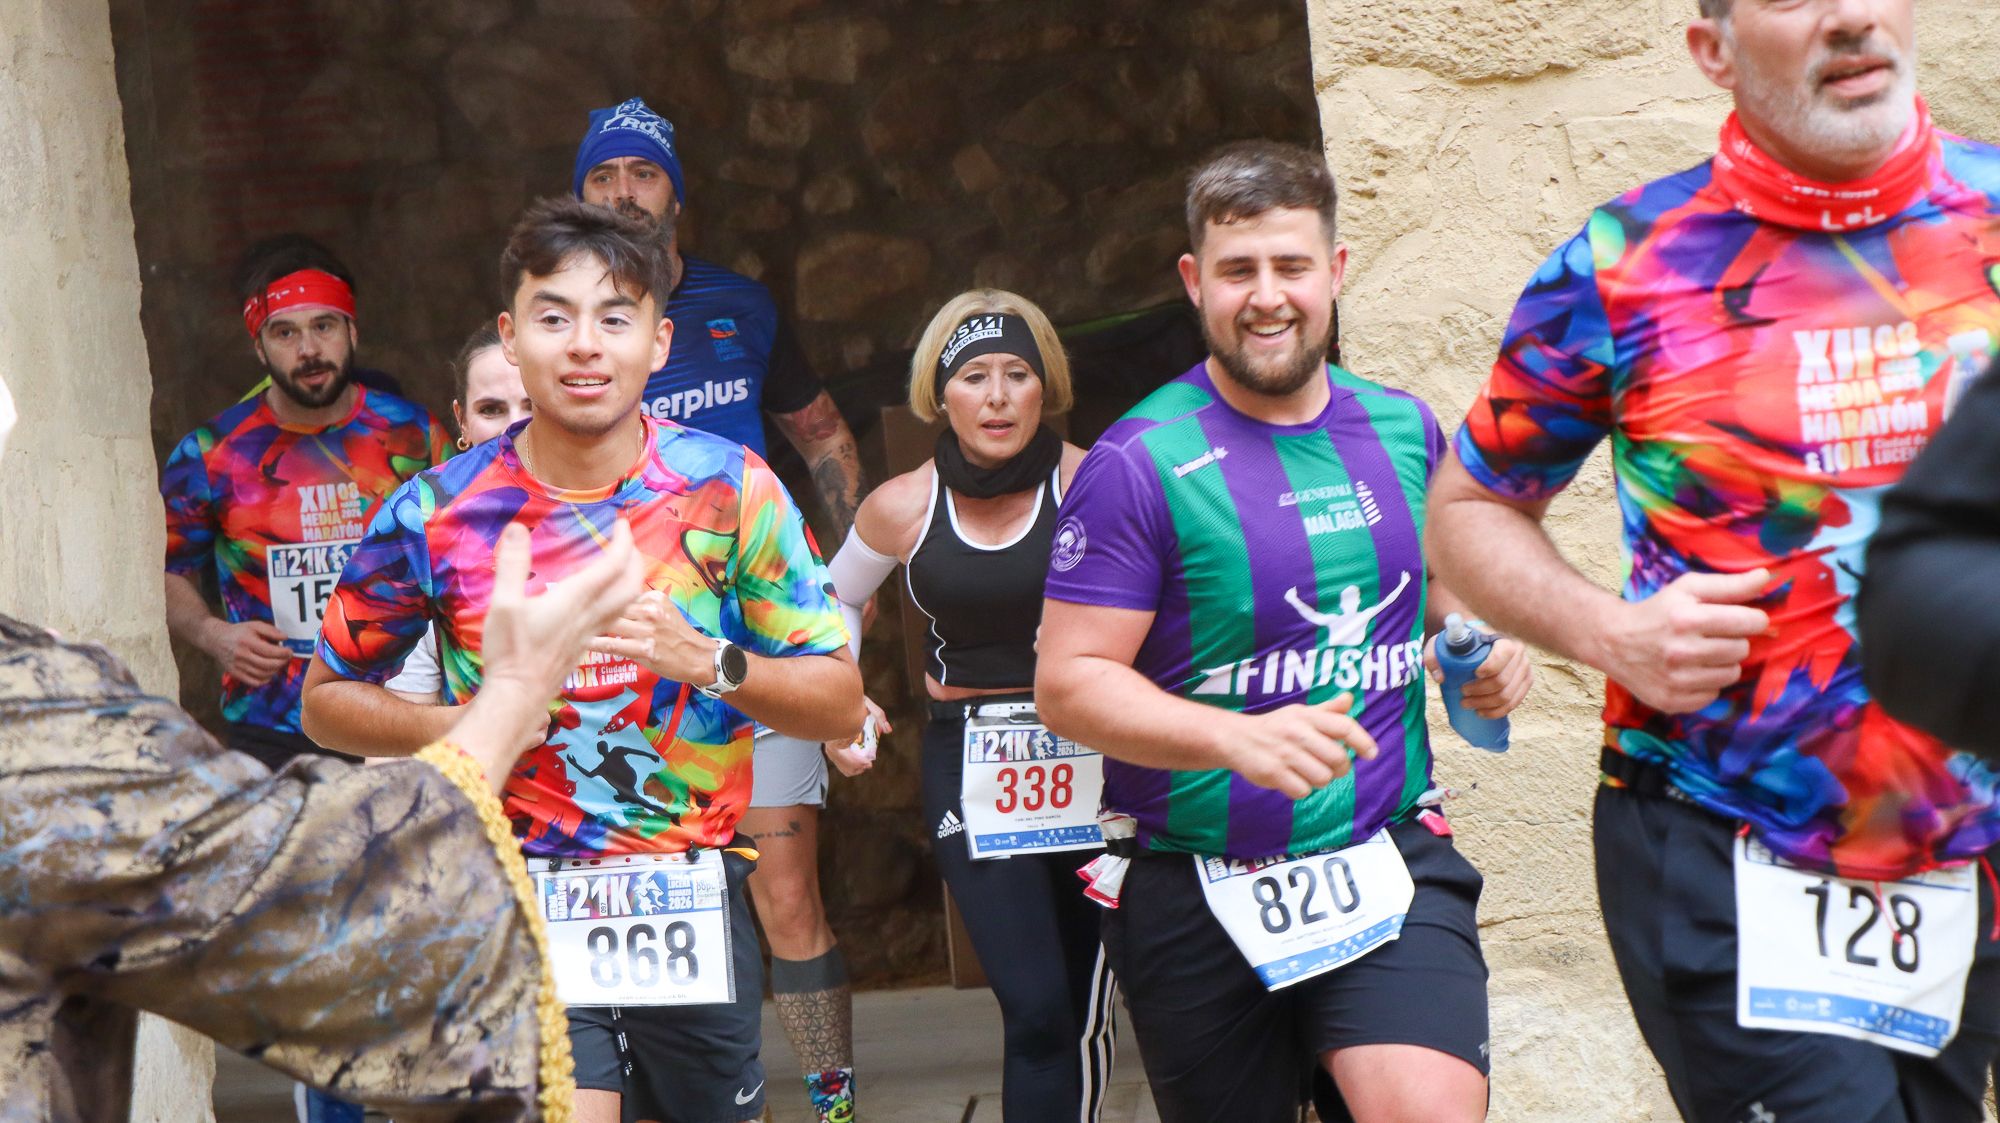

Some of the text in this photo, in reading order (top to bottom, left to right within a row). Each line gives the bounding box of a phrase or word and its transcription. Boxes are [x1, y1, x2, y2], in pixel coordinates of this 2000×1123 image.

[1793, 326, 1875, 384] XII
[1797, 378, 1884, 413] MEDIA
[1801, 396, 1928, 443] MARATÓN
[1820, 439, 1871, 473] 10K
[1873, 446, 1921, 466] LUCEN
[297, 481, 360, 513] XII 08
[301, 510, 342, 527] MEDIA
[303, 521, 364, 542] MARATÓN
[1304, 508, 1368, 537] MÁLAGA
[287, 547, 330, 577] 21K
[601, 665, 627, 675] Ciudad
[628, 663, 638, 673] de
[601, 671, 638, 686] LUCENA
[985, 731, 1031, 763] 21K
[995, 763, 1074, 814] 338
[569, 874, 633, 919] 21K
[668, 895, 693, 911] 2026
[1252, 856, 1361, 934] 820
[1804, 880, 1922, 974] 128
[587, 920, 699, 988] 868
